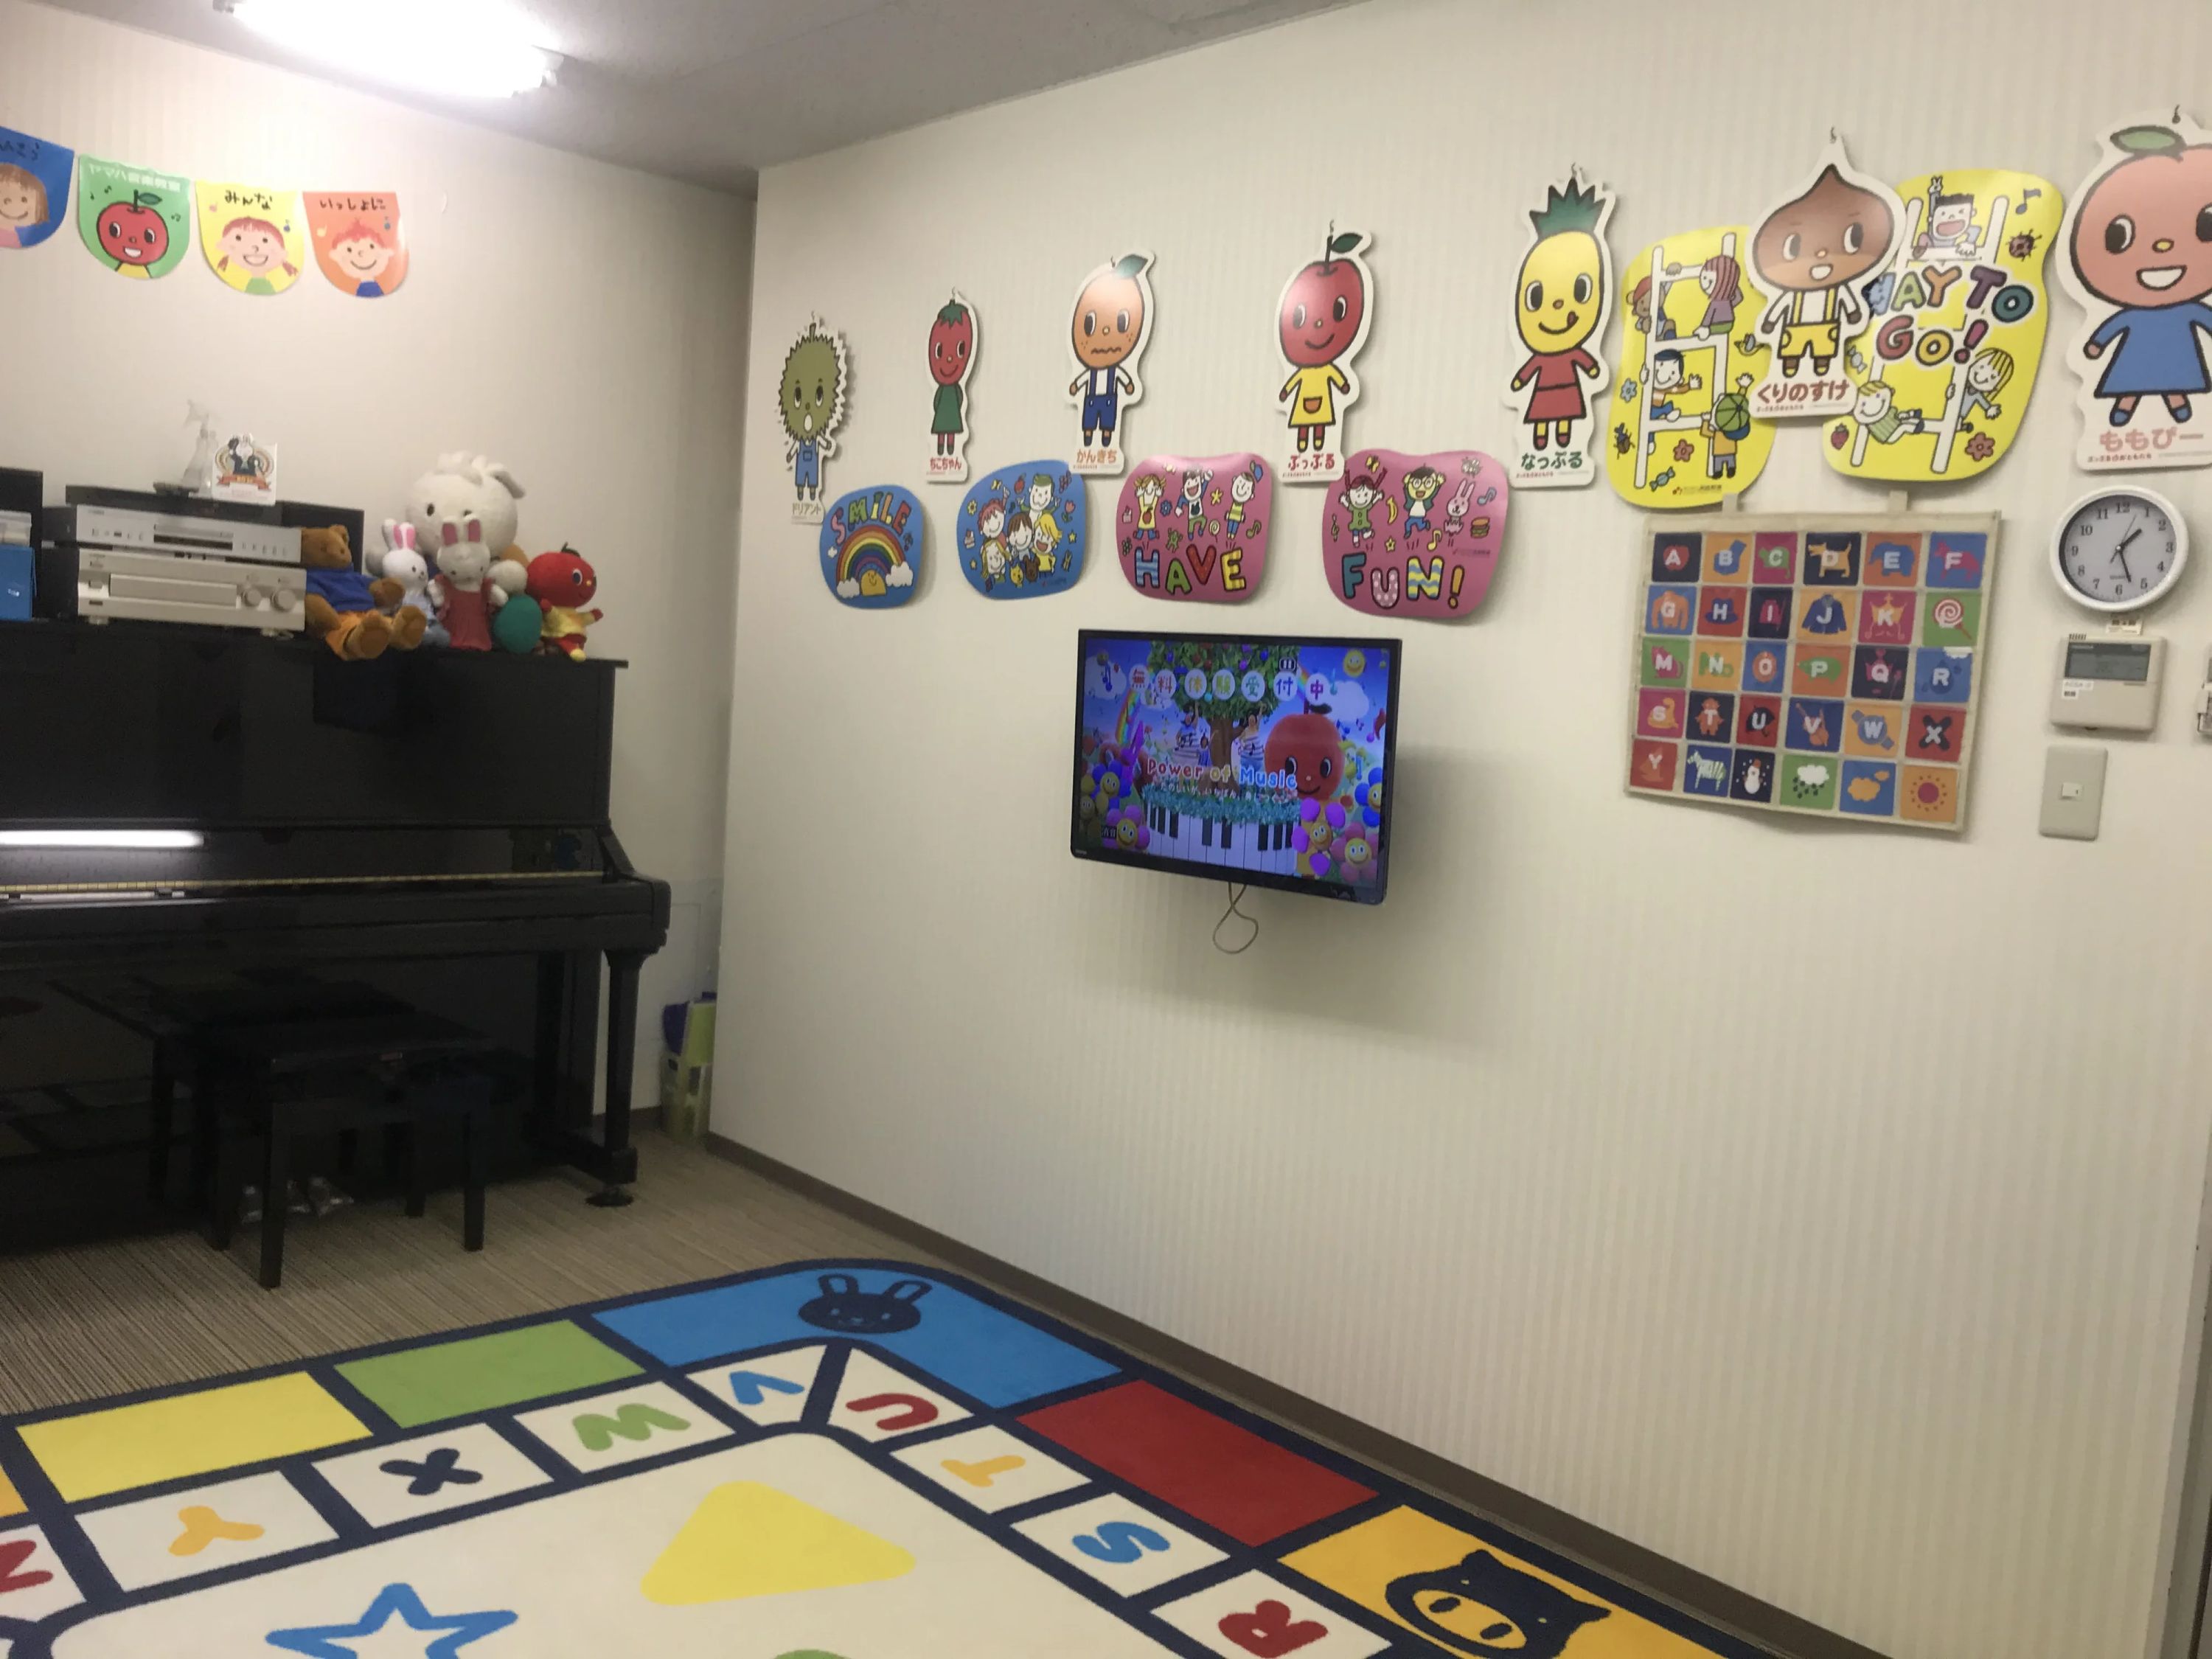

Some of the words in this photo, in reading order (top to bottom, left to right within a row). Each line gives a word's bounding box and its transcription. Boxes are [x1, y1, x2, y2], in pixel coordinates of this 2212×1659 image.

[223, 189, 273, 211] みんな
[319, 197, 386, 212] いっしょに
[1966, 265, 2034, 322] TO
[1876, 314, 1989, 366] GO!
[1757, 379, 1850, 404] くりのすけ
[929, 456, 962, 471] ちこちゃん
[1288, 453, 1335, 471] ぷっぷる
[830, 491, 912, 547] SMILE
[2096, 508, 2109, 521] 11
[2115, 501, 2131, 514] 12
[2144, 506, 2150, 518] 1
[2080, 525, 2093, 536] 10
[2157, 519, 2166, 532] 2
[2071, 546, 2079, 557] 9
[2166, 541, 2174, 554] 3
[1134, 543, 1247, 596] HAVE
[1664, 549, 1681, 566] A
[1718, 549, 1733, 566] B
[1768, 549, 1784, 566] C
[1821, 550, 1839, 568] D
[1883, 552, 1900, 569] E
[1944, 552, 1963, 570] F
[2077, 565, 2086, 577] 8
[2157, 560, 2165, 572] 4
[1340, 552, 1465, 610] FUN!
[2093, 578, 2101, 590] 7
[2115, 584, 2124, 596] 6
[2140, 577, 2149, 590] 5
[1660, 601, 1675, 618] G
[1712, 602, 1728, 621] H
[1767, 605, 1773, 622] I
[1816, 606, 1833, 625] J
[1877, 608, 1893, 627] K
[1655, 653, 1673, 672] M
[1708, 654, 1725, 675] N
[1759, 658, 1773, 676] O
[1811, 661, 1829, 678] P
[1871, 663, 1890, 684] Q
[1932, 667, 1951, 686] R
[1132, 668, 1324, 701] 無料体験受付中
[1652, 705, 1667, 722] S
[1703, 709, 1718, 726] T
[1751, 712, 1767, 731] U
[1804, 716, 1822, 734] V
[1863, 720, 1884, 740] W
[1924, 725, 1942, 745] X
[1147, 757, 1203, 780] Power
[1210, 764, 1231, 783] of
[1238, 765, 1298, 789] Music
[1648, 753, 1663, 771] Y
[728, 1370, 805, 1405] V
[844, 1393, 939, 1431] U
[379, 1447, 484, 1496] X
[940, 1454, 1026, 1488] T
[167, 1506, 265, 1557] Y
[1071, 1520, 1171, 1565] S
[1218, 1599, 1329, 1658] R
